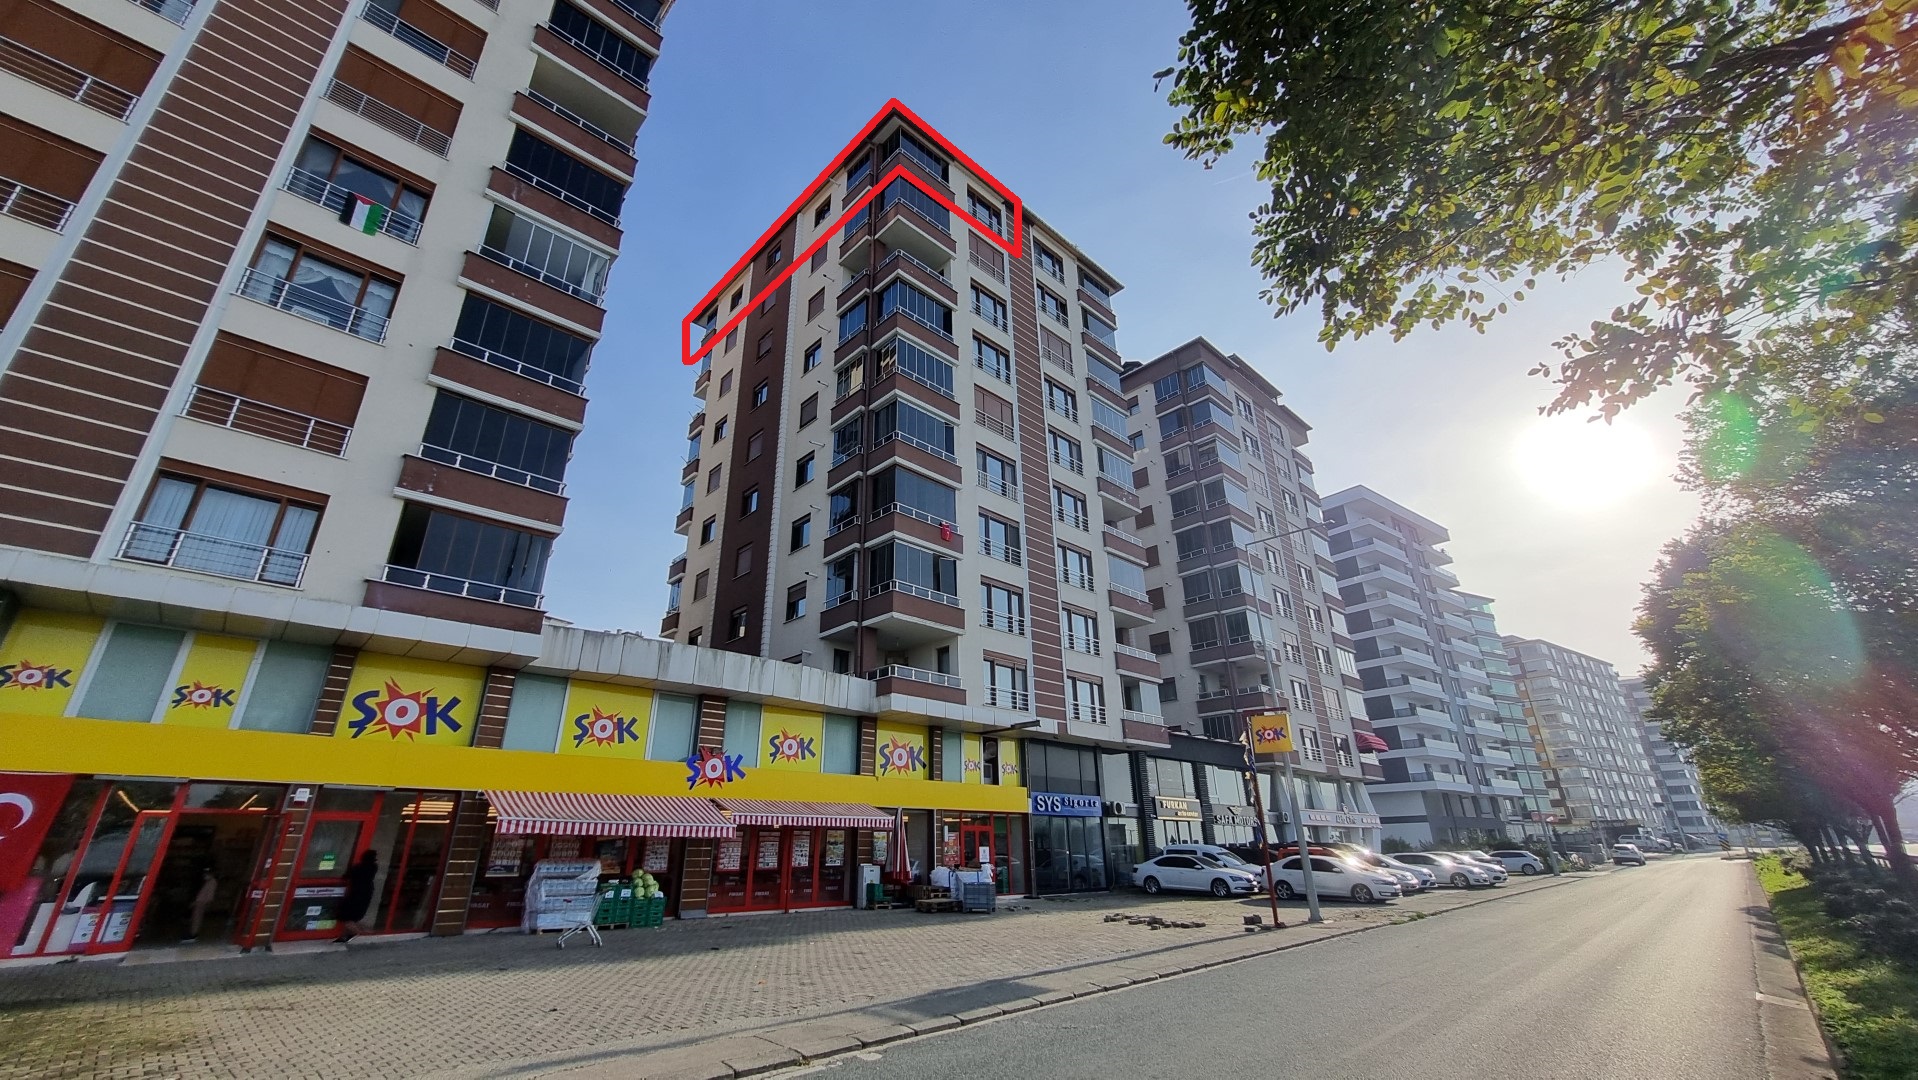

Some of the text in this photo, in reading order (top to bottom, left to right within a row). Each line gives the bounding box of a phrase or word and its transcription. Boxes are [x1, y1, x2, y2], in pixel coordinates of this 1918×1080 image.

[172, 681, 236, 709] ŞOK
[348, 690, 462, 739] ŞOK
[573, 713, 640, 749] ŞOK
[1255, 727, 1287, 745] ŞOK
[769, 733, 816, 764] ŞOK
[879, 744, 927, 775] ŞOK
[686, 751, 746, 790] ŞOK
[1037, 795, 1061, 812] SYS
[1064, 797, 1100, 808] Sigorta
[1162, 800, 1188, 810] FURKAN
[1216, 815, 1233, 825] SAFA
